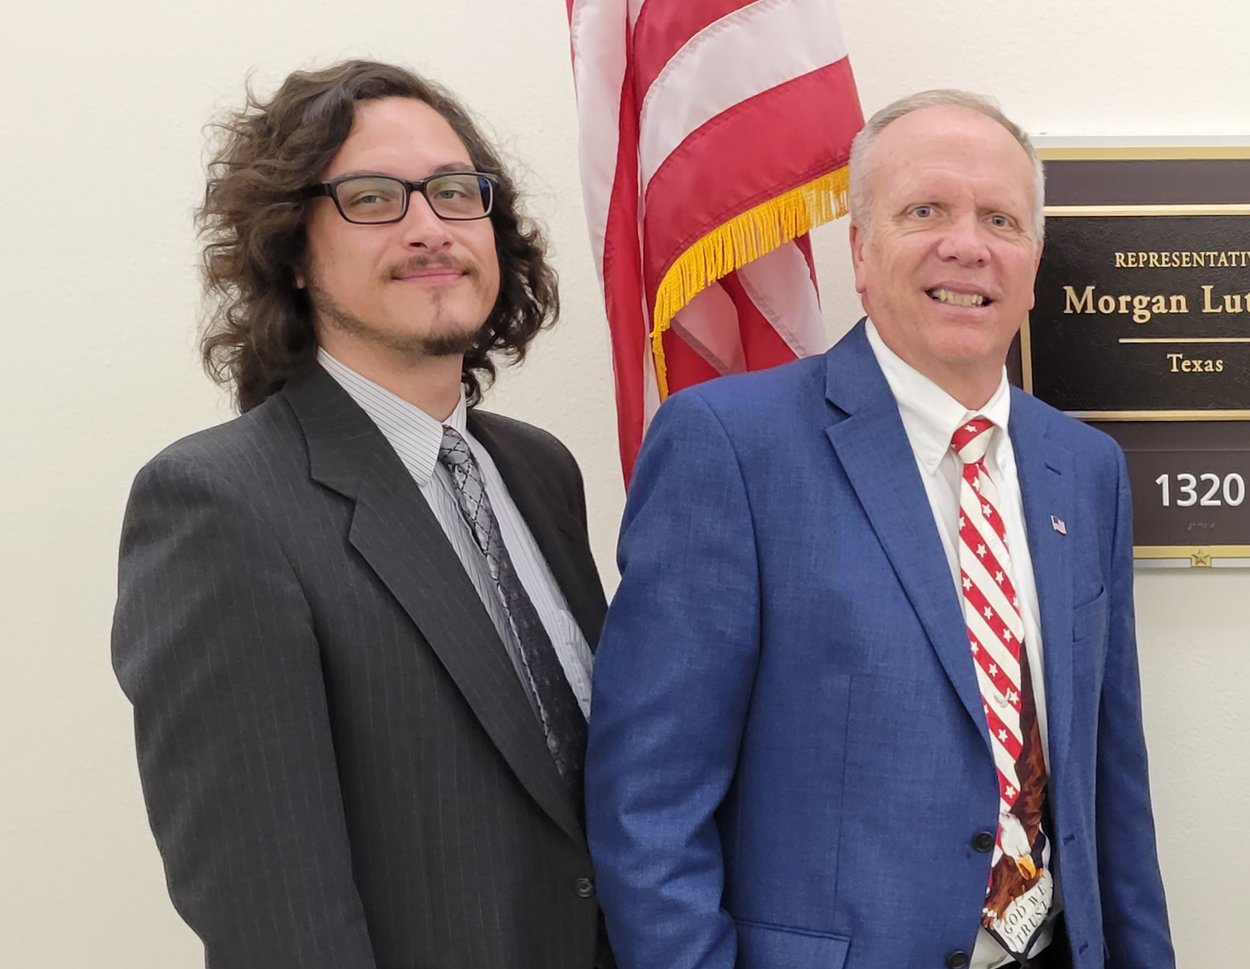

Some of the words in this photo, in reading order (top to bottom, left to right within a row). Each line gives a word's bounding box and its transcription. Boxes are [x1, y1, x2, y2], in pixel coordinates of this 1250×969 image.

[1062, 286, 1188, 324] Morgan
[1167, 353, 1224, 372] Texas
[1155, 472, 1246, 507] 1320
